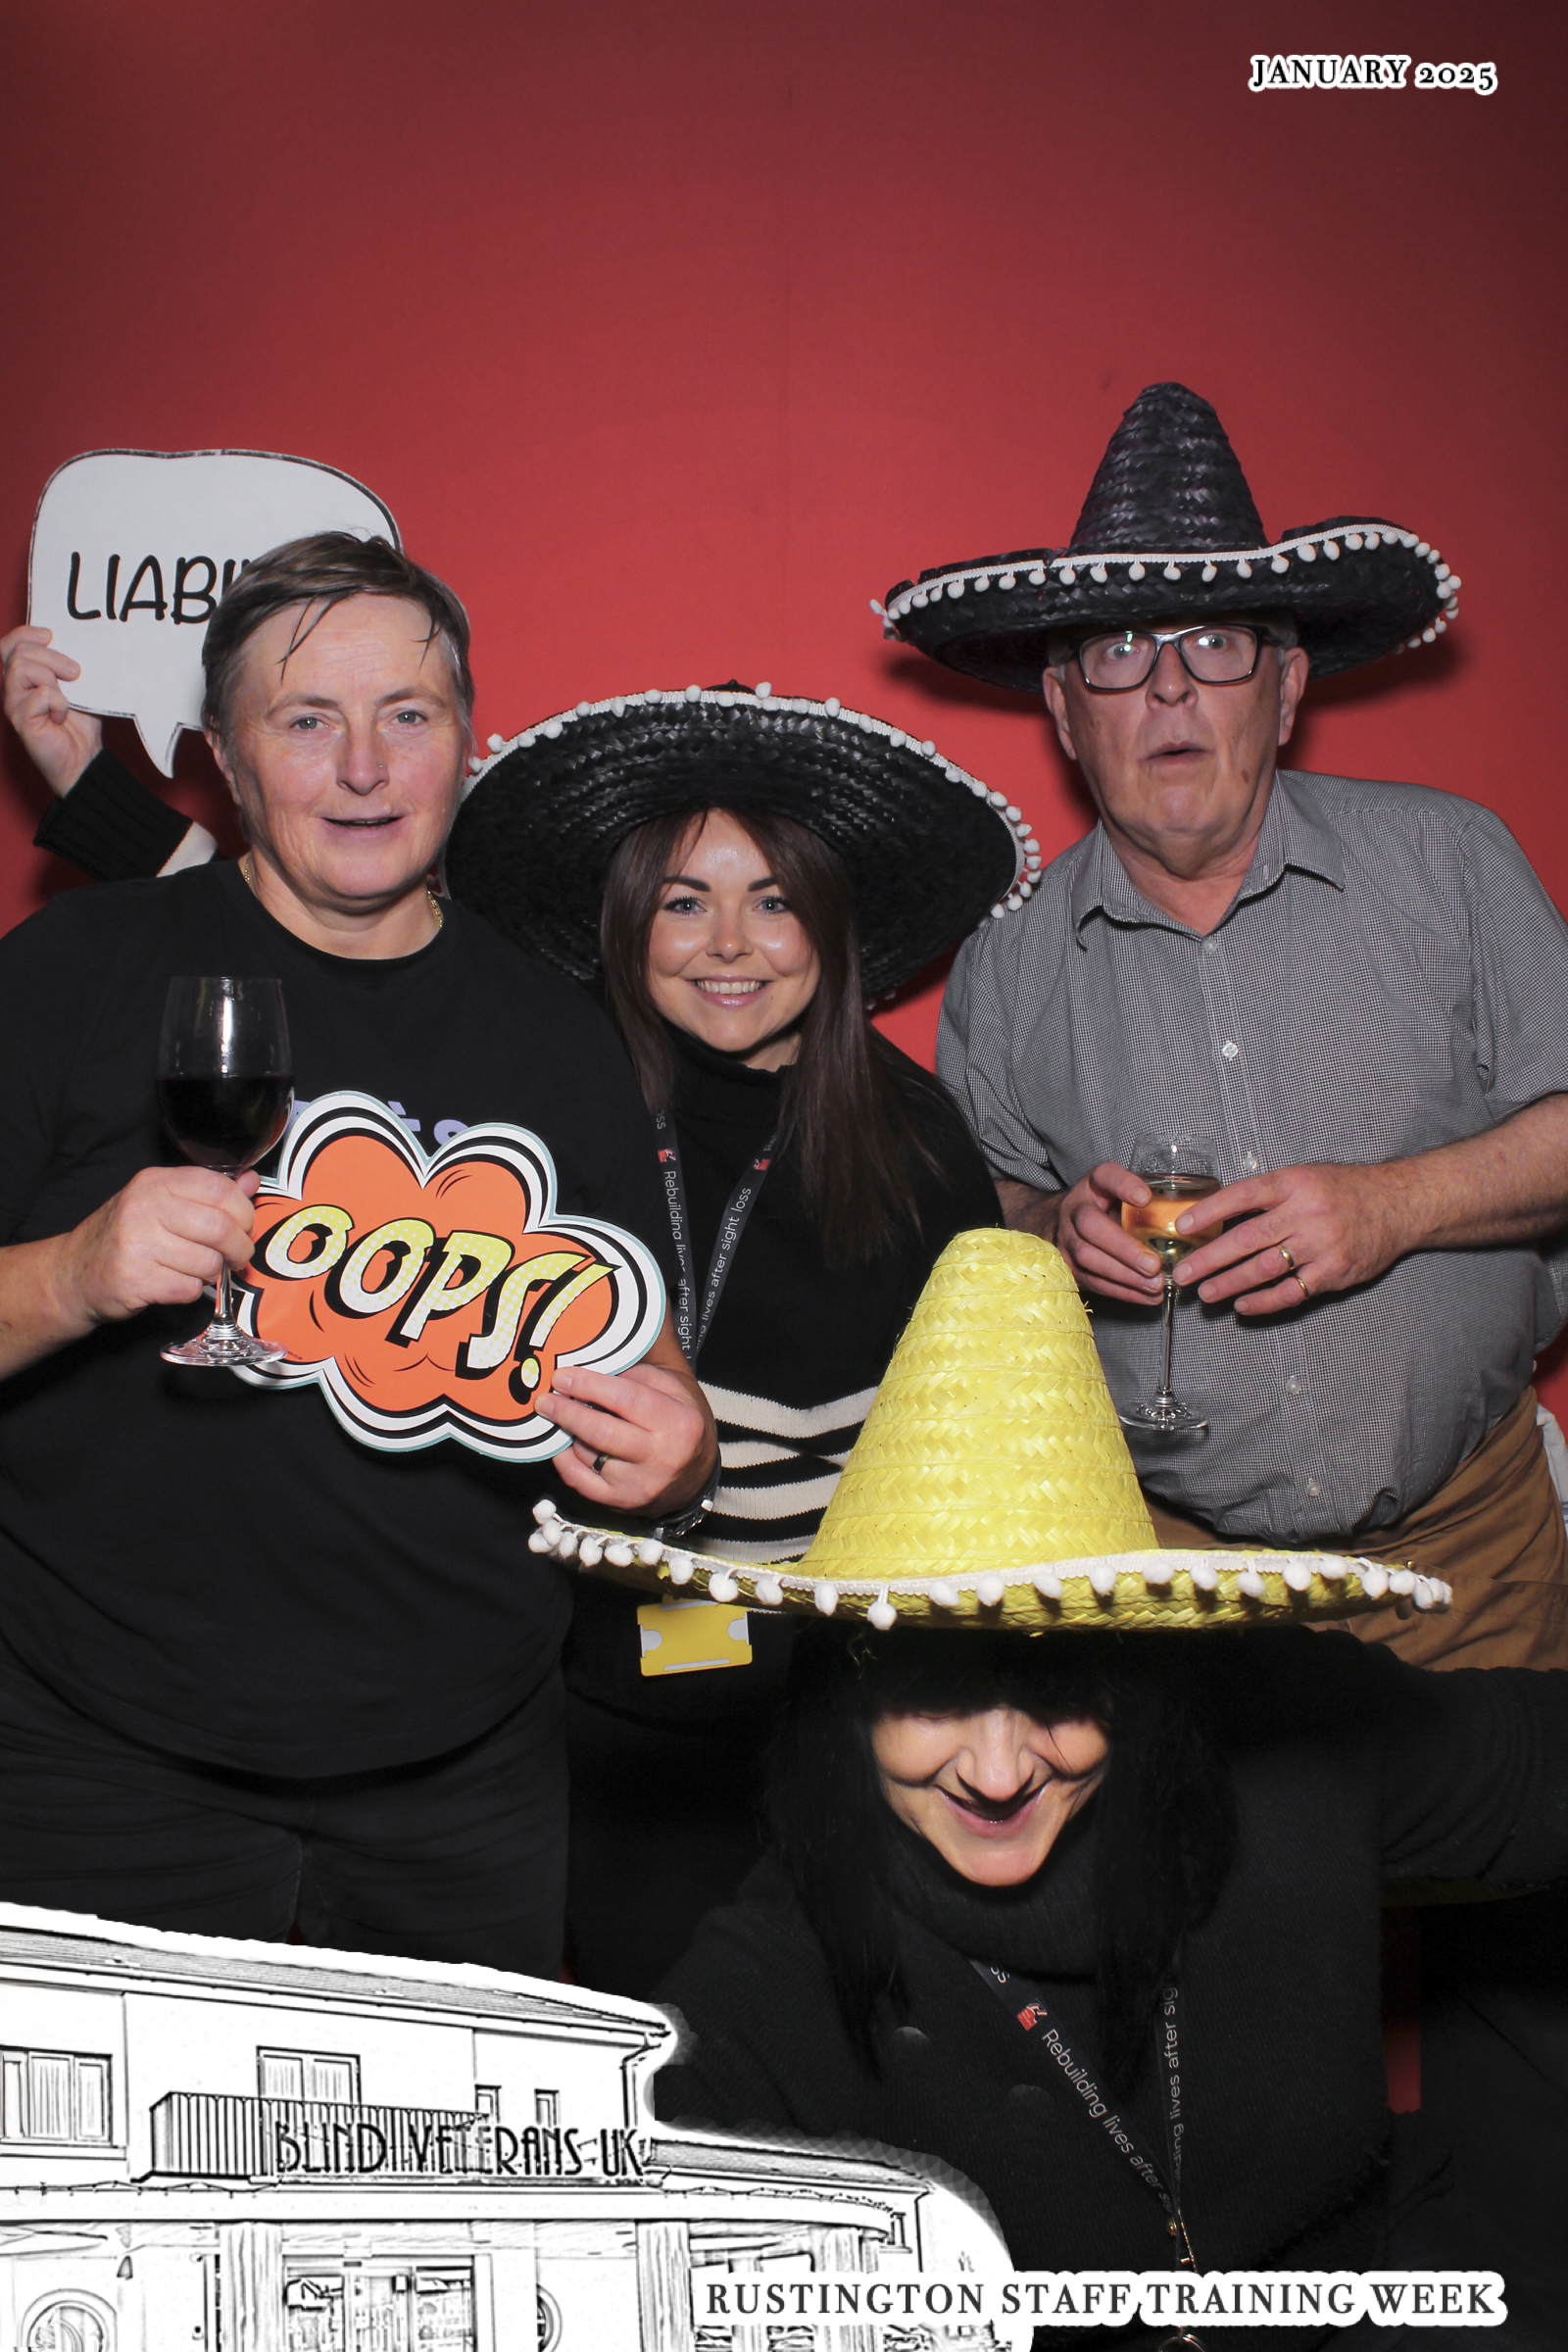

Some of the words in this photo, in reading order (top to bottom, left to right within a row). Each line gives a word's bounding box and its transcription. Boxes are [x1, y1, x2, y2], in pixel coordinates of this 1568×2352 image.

[67, 551, 251, 624] LIABI
[702, 1291, 715, 1321] lives
[710, 1253, 727, 1288] after
[720, 1216, 740, 1250] sight
[730, 1188, 752, 1213] loss
[253, 1203, 620, 1403] OOPS!
[677, 1315, 692, 1350] sight
[1160, 1987, 1178, 2016] sig
[1164, 2022, 1179, 2069] after
[1042, 2029, 1107, 2118] Rebuilding
[1102, 2115, 1134, 2154] lives
[1130, 2156, 1164, 2188] after
[1169, 2075, 1181, 2119] lives
